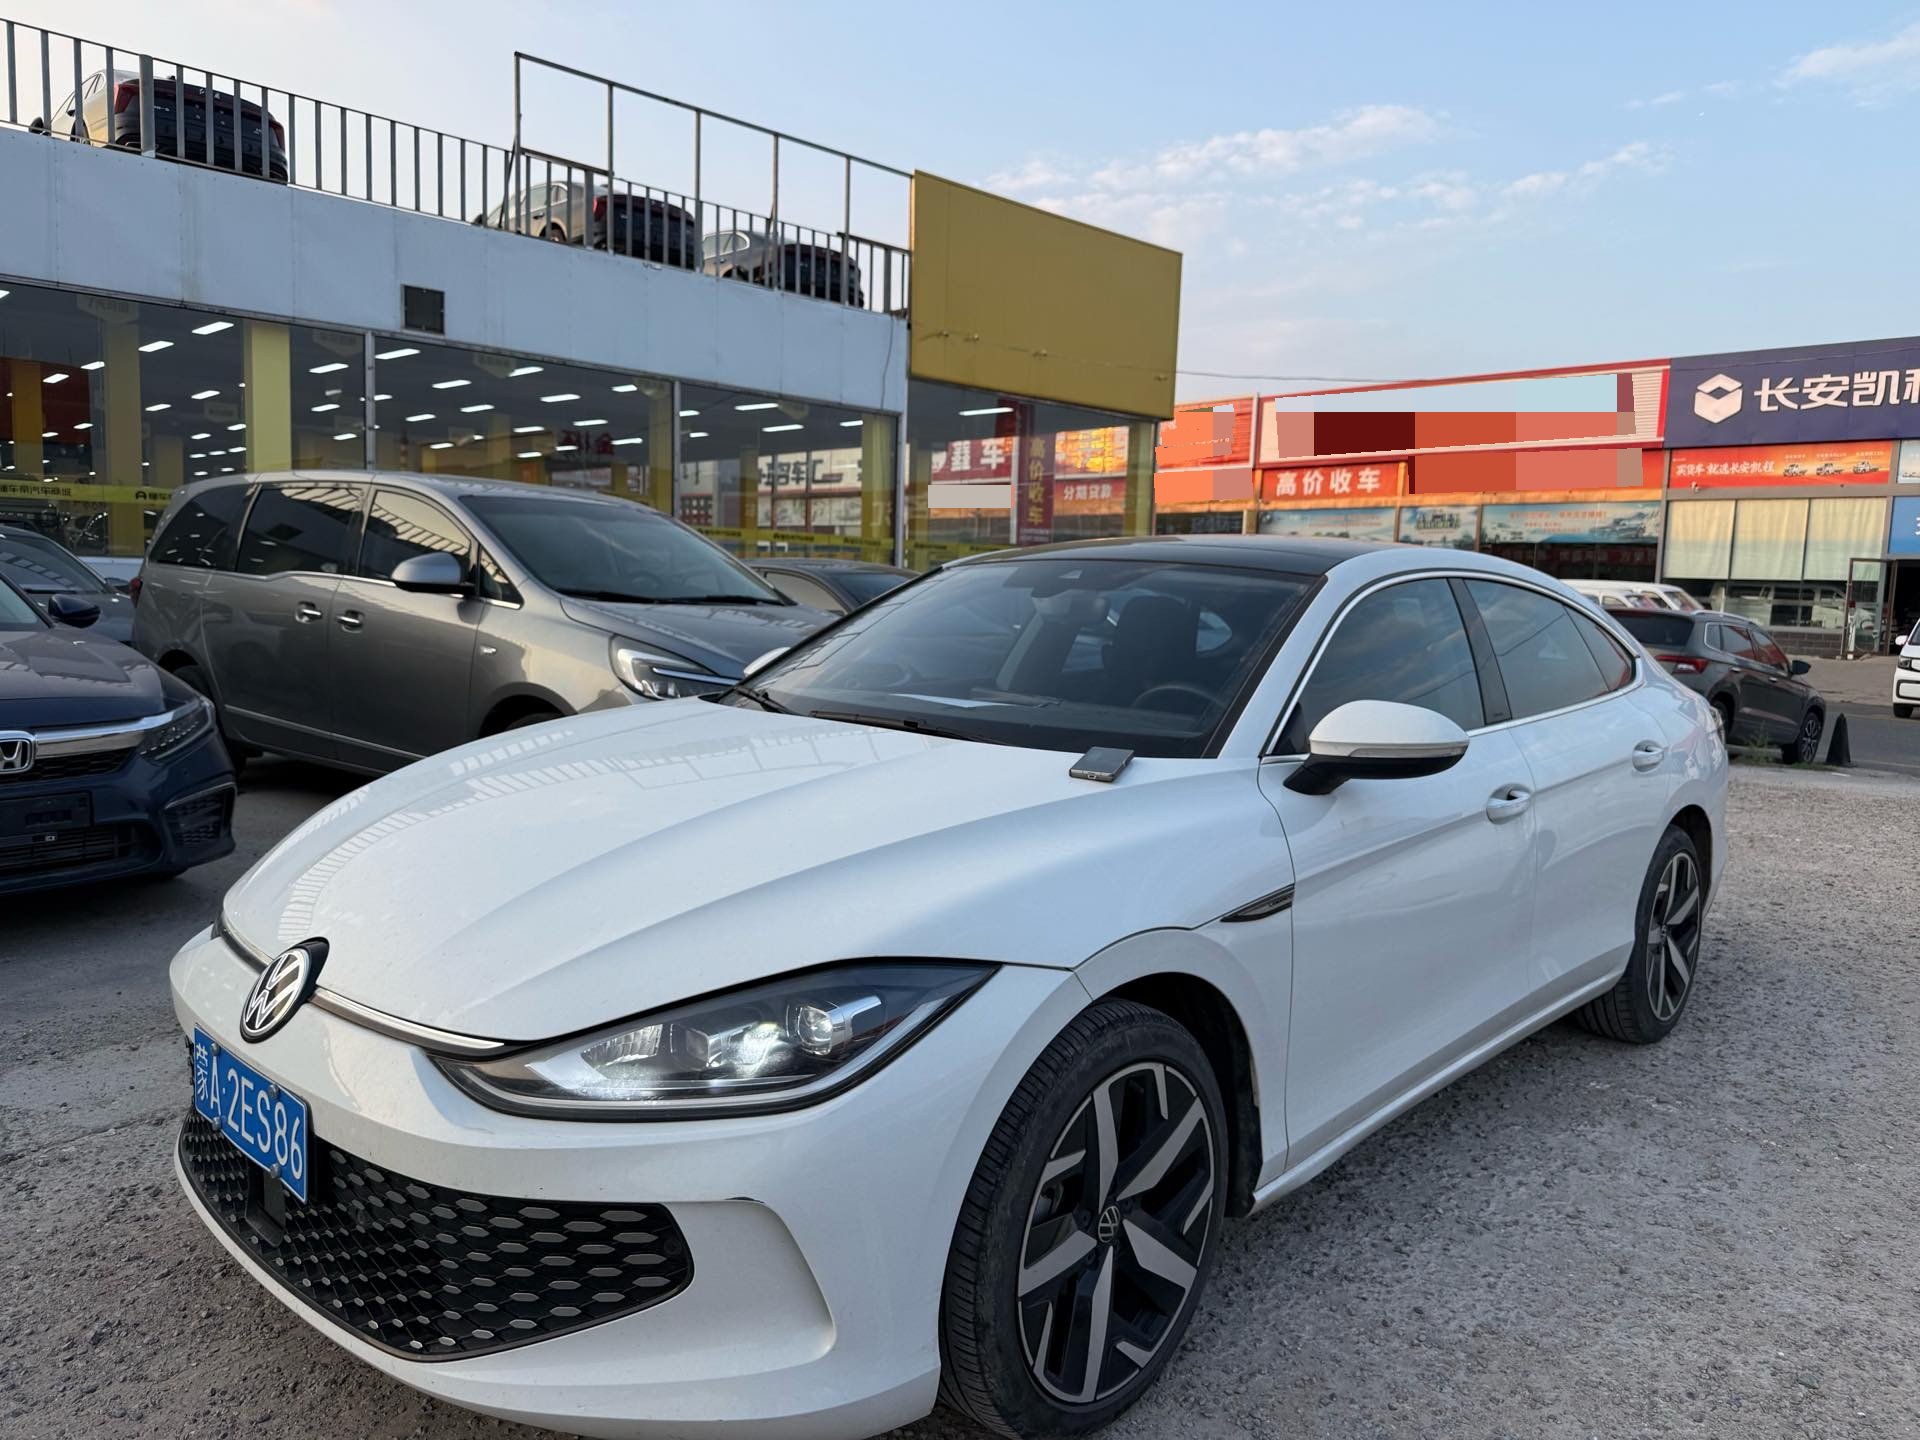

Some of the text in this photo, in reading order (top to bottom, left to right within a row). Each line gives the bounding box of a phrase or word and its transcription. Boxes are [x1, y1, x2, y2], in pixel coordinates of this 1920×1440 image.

[1063, 483, 1113, 501] 分期贷款
[1275, 467, 1381, 496] 高价收车
